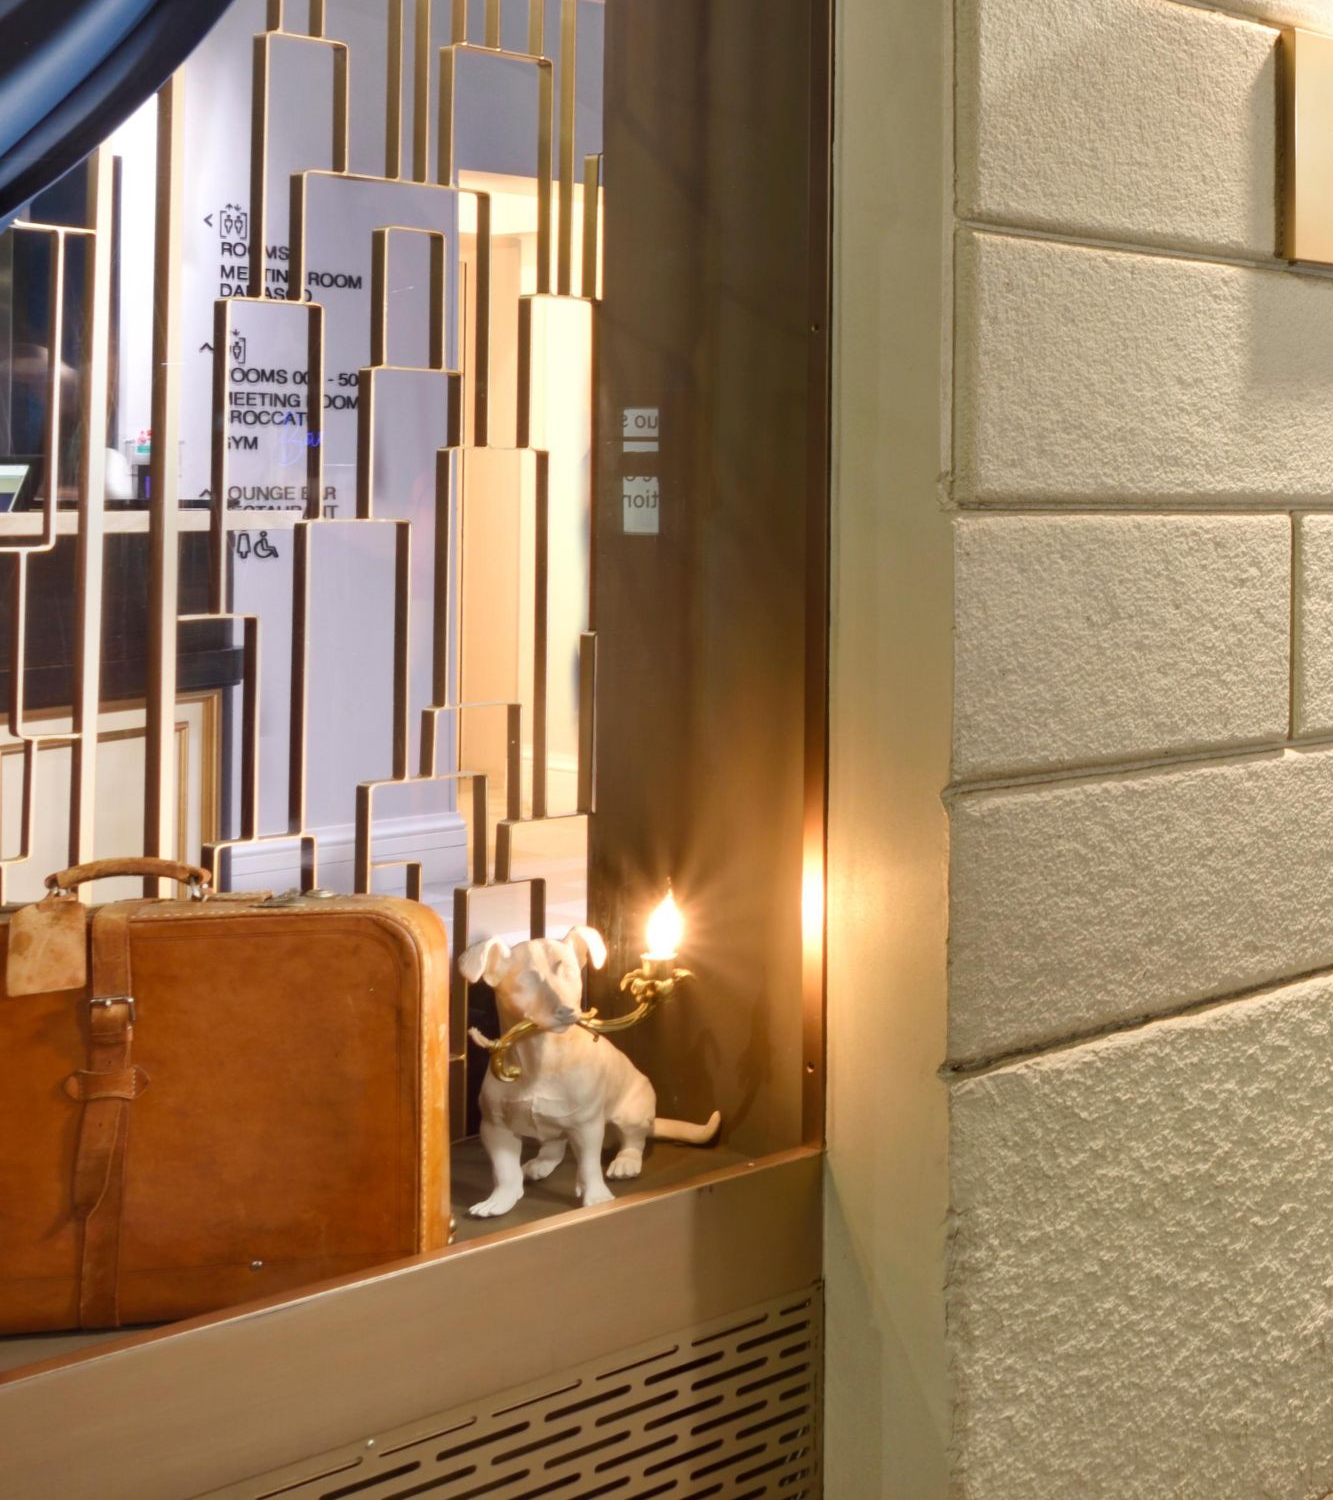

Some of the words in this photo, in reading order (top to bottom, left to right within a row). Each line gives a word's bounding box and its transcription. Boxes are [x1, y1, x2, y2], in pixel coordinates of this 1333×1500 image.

[220, 241, 290, 261] ROMS
[220, 264, 290, 284] METIN
[308, 271, 363, 290] ROOM
[229, 367, 288, 385] OOMS
[229, 391, 300, 408] EETING
[229, 409, 308, 427] ROCCAT
[227, 485, 296, 501] OUNGE
